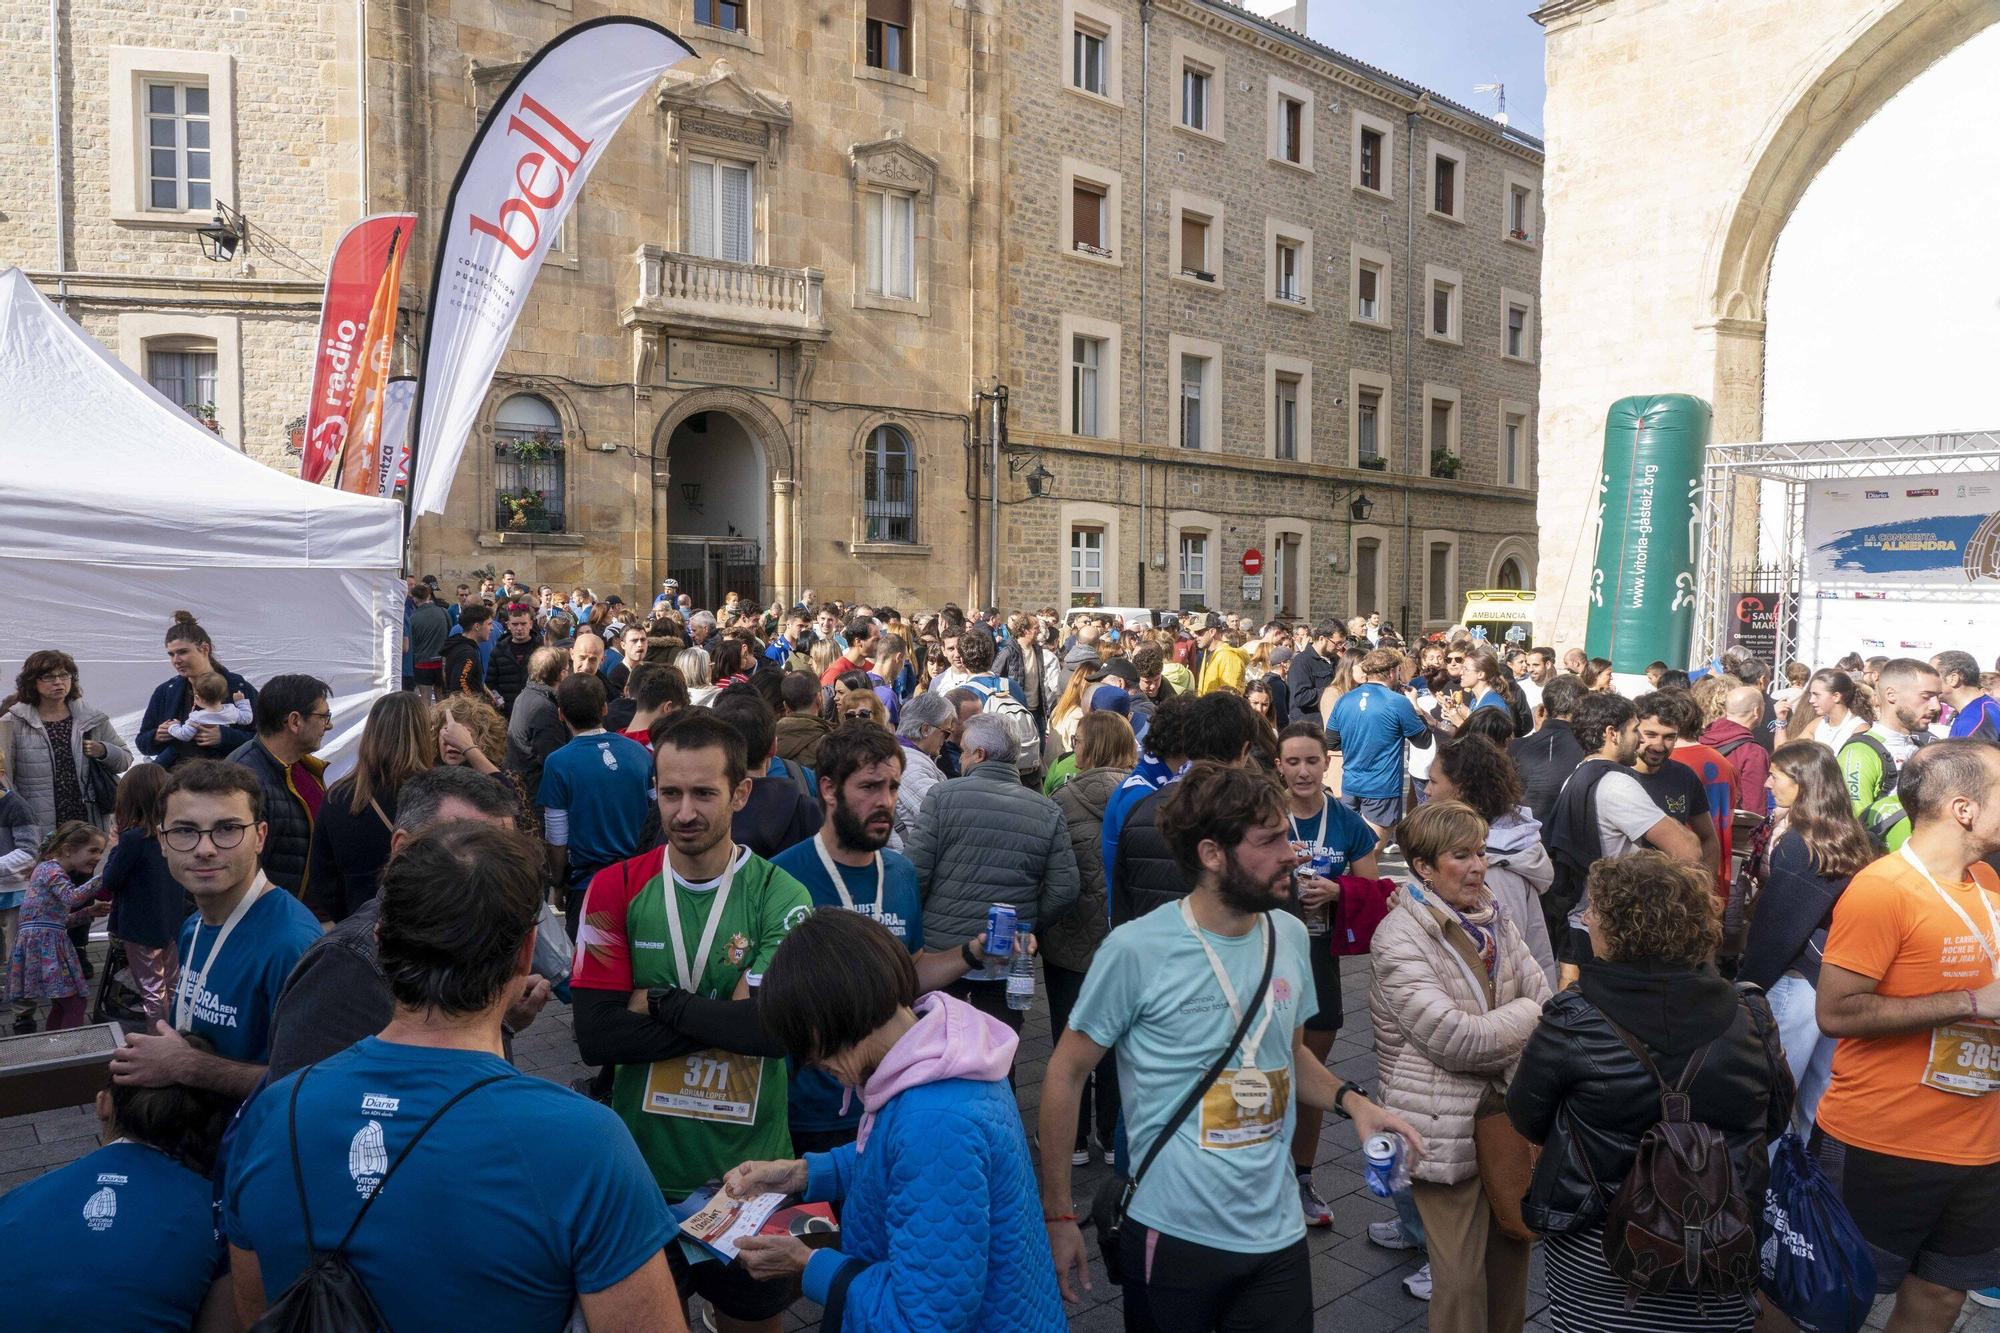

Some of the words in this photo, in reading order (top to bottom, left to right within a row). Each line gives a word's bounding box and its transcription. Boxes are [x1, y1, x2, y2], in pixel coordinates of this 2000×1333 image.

[470, 93, 594, 260] bell
[326, 320, 356, 406] radio
[1633, 464, 1658, 608] www.vitoria-gasteiz.org
[1878, 533, 1937, 541] CONQUISTA
[1882, 540, 1956, 551] ALMENDRA
[193, 1005, 237, 1028] ONKISTA
[684, 1055, 730, 1090] 371
[680, 1087, 705, 1098] ADRIAN
[365, 1098, 395, 1109] Diario
[357, 1177, 381, 1185] VITORI
